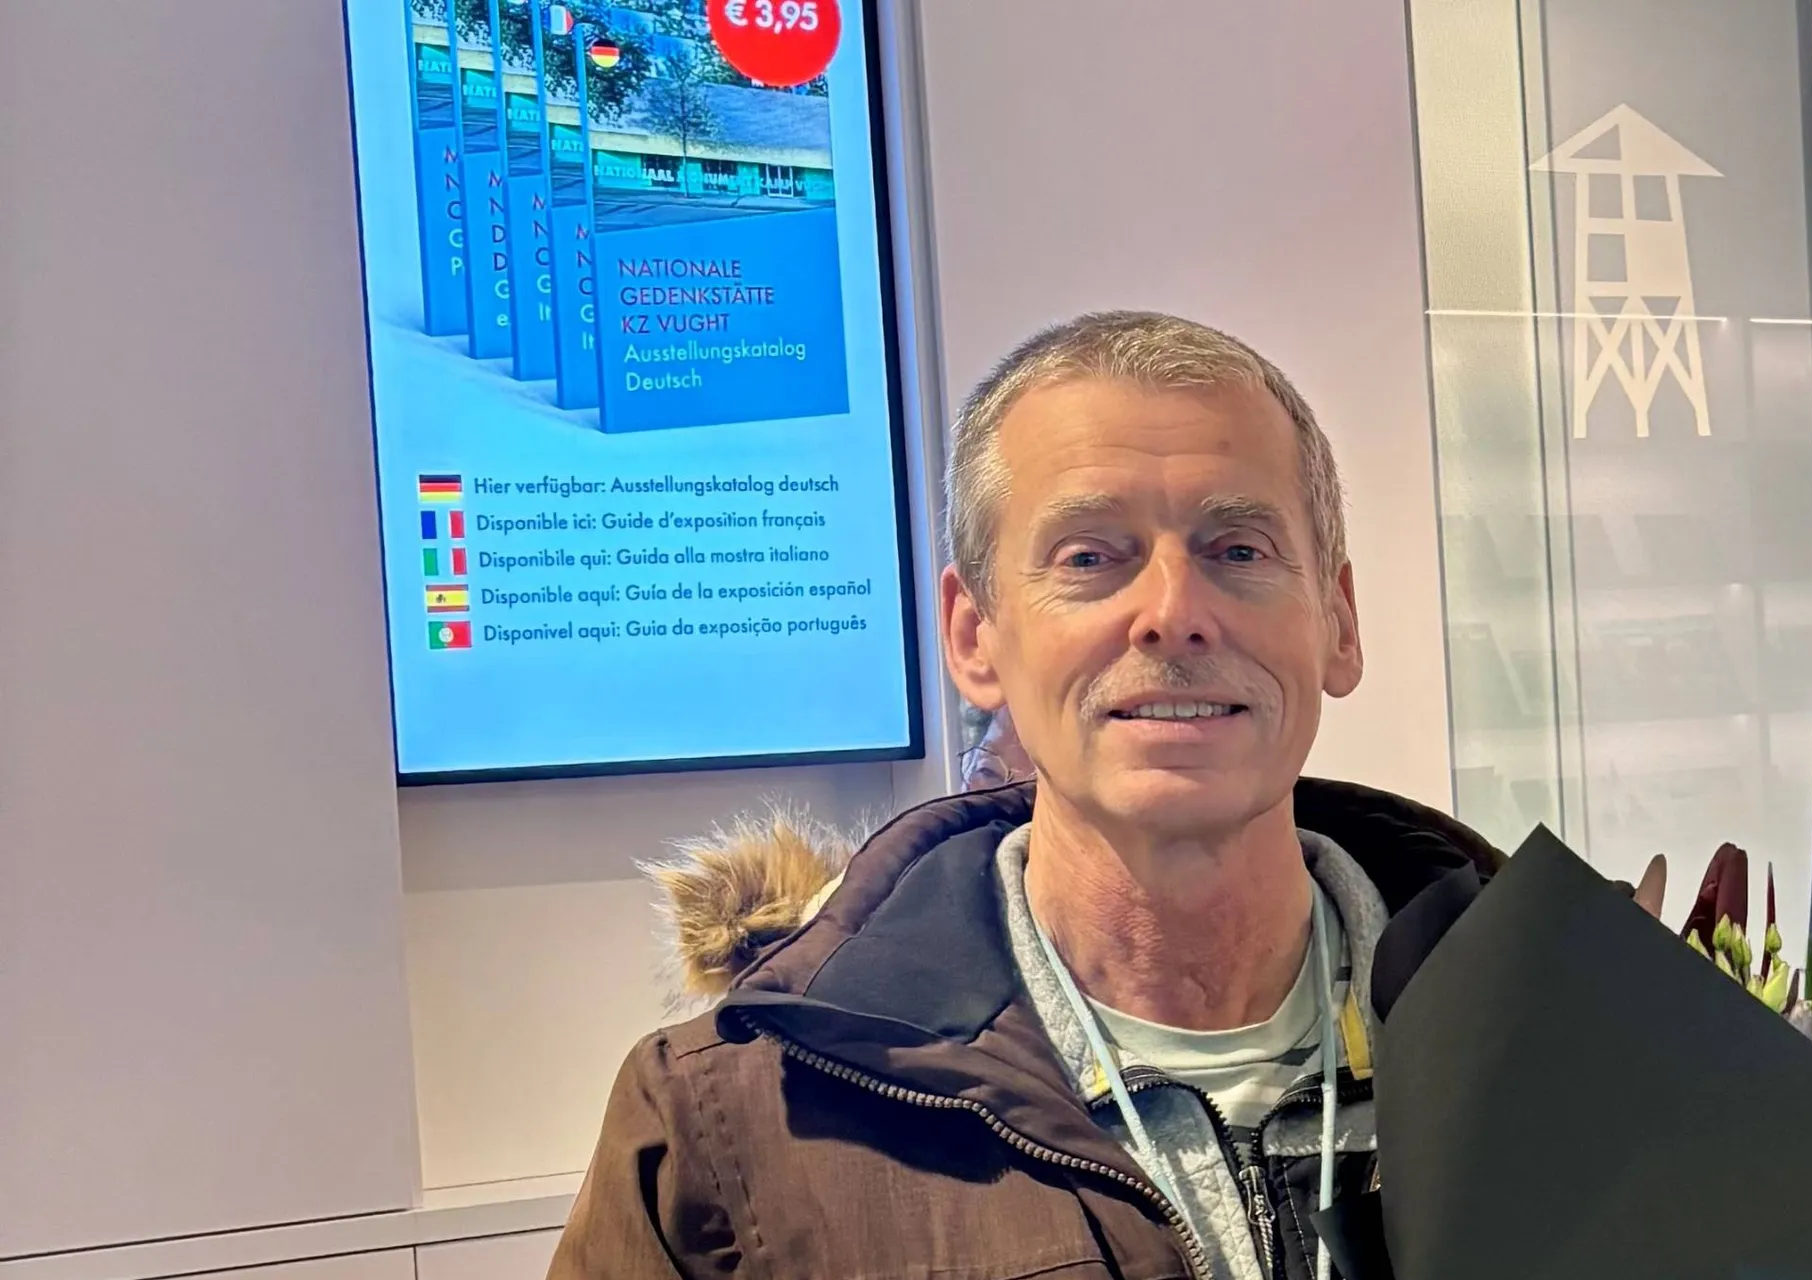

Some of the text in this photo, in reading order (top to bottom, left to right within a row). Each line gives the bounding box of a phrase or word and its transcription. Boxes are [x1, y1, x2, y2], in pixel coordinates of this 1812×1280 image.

[724, 0, 819, 35] € 3,95
[618, 257, 743, 279] NATIONALE
[620, 282, 775, 306] GEDENKSTÄTTE
[622, 313, 730, 334] KZ VUGHT
[624, 337, 806, 364] Ausstellungskatalog
[626, 368, 702, 391] Deutsch
[474, 474, 839, 498] Hier verfügbar: Ausstellungskatalog deutsch
[476, 512, 568, 536] Disponible
[573, 513, 596, 530] ici:
[602, 512, 653, 529] Guide
[762, 509, 826, 531] français
[479, 545, 829, 572] Disponibile qui: Guida alla mostra italiano
[481, 578, 871, 608] Disponible aquí: Guía de la exposición español
[578, 621, 620, 643] aqui:
[626, 620, 667, 636] Guia
[672, 617, 693, 635] da
[699, 617, 782, 638] exposição
[787, 614, 867, 636] português
